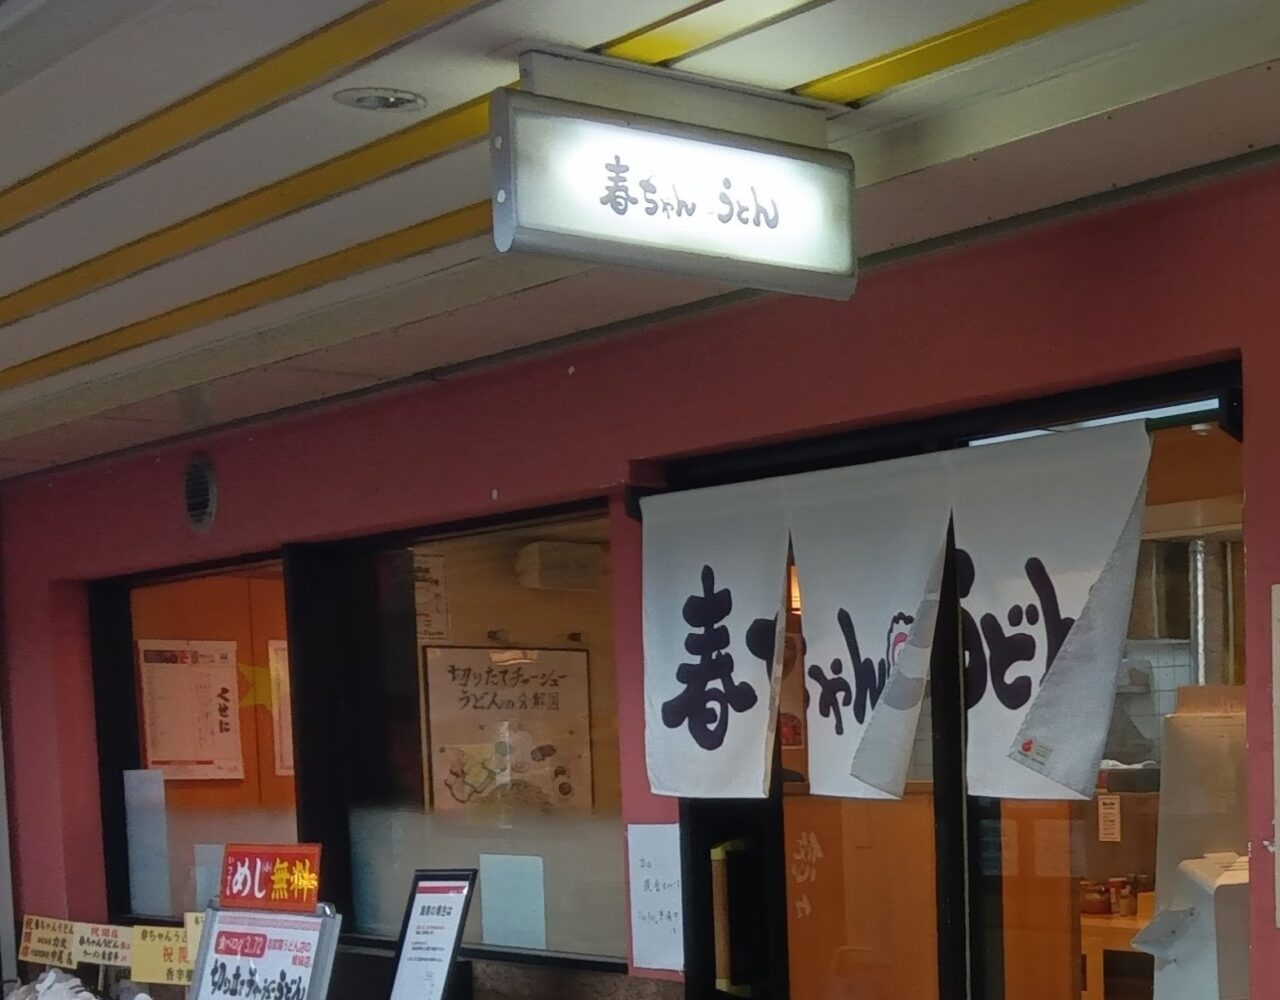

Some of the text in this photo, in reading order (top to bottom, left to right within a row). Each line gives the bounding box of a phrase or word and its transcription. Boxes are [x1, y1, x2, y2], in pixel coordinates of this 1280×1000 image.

[600, 155, 696, 219] 春ちゃん
[232, 857, 266, 899] めし
